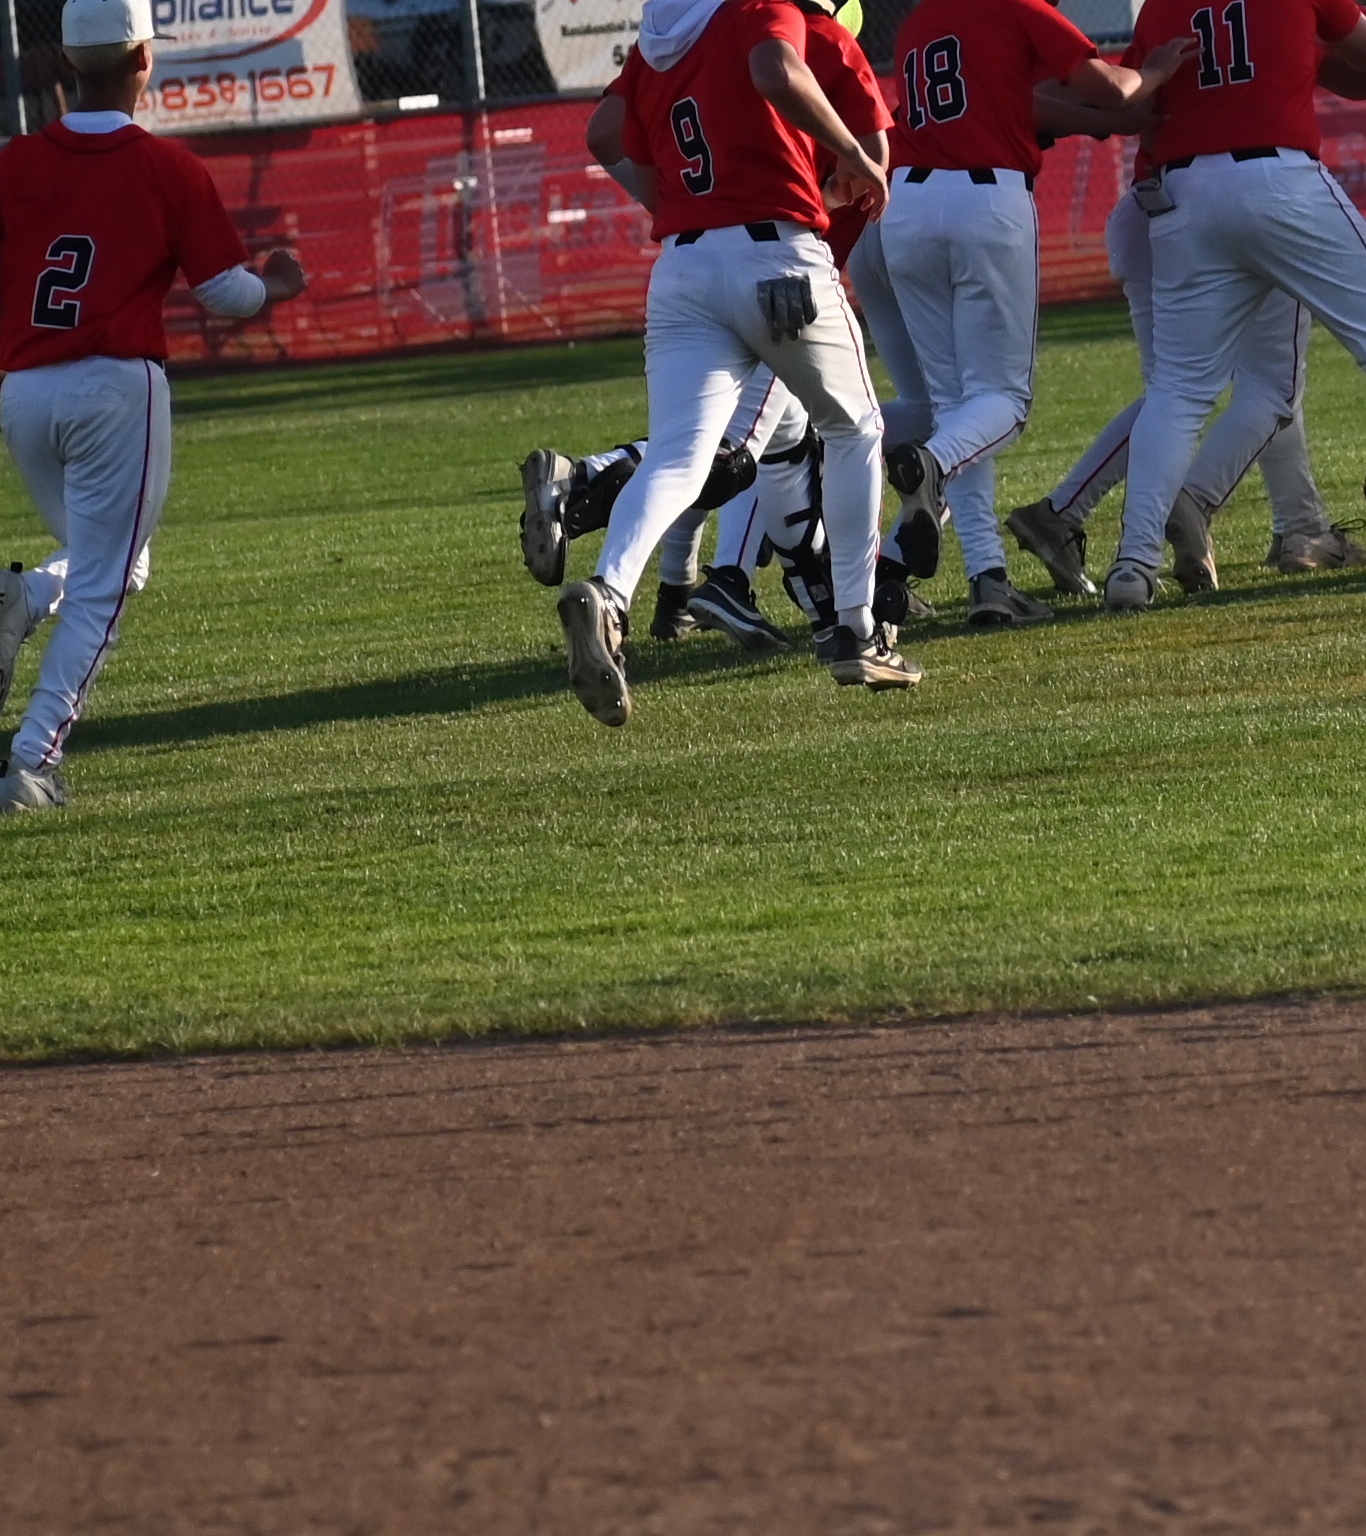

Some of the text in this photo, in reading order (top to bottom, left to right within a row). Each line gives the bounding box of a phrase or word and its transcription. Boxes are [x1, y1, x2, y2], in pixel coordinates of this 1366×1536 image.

[903, 35, 967, 132] 18
[1190, 0, 1255, 89] 11
[670, 97, 715, 196] 9
[31, 234, 96, 330] 2
